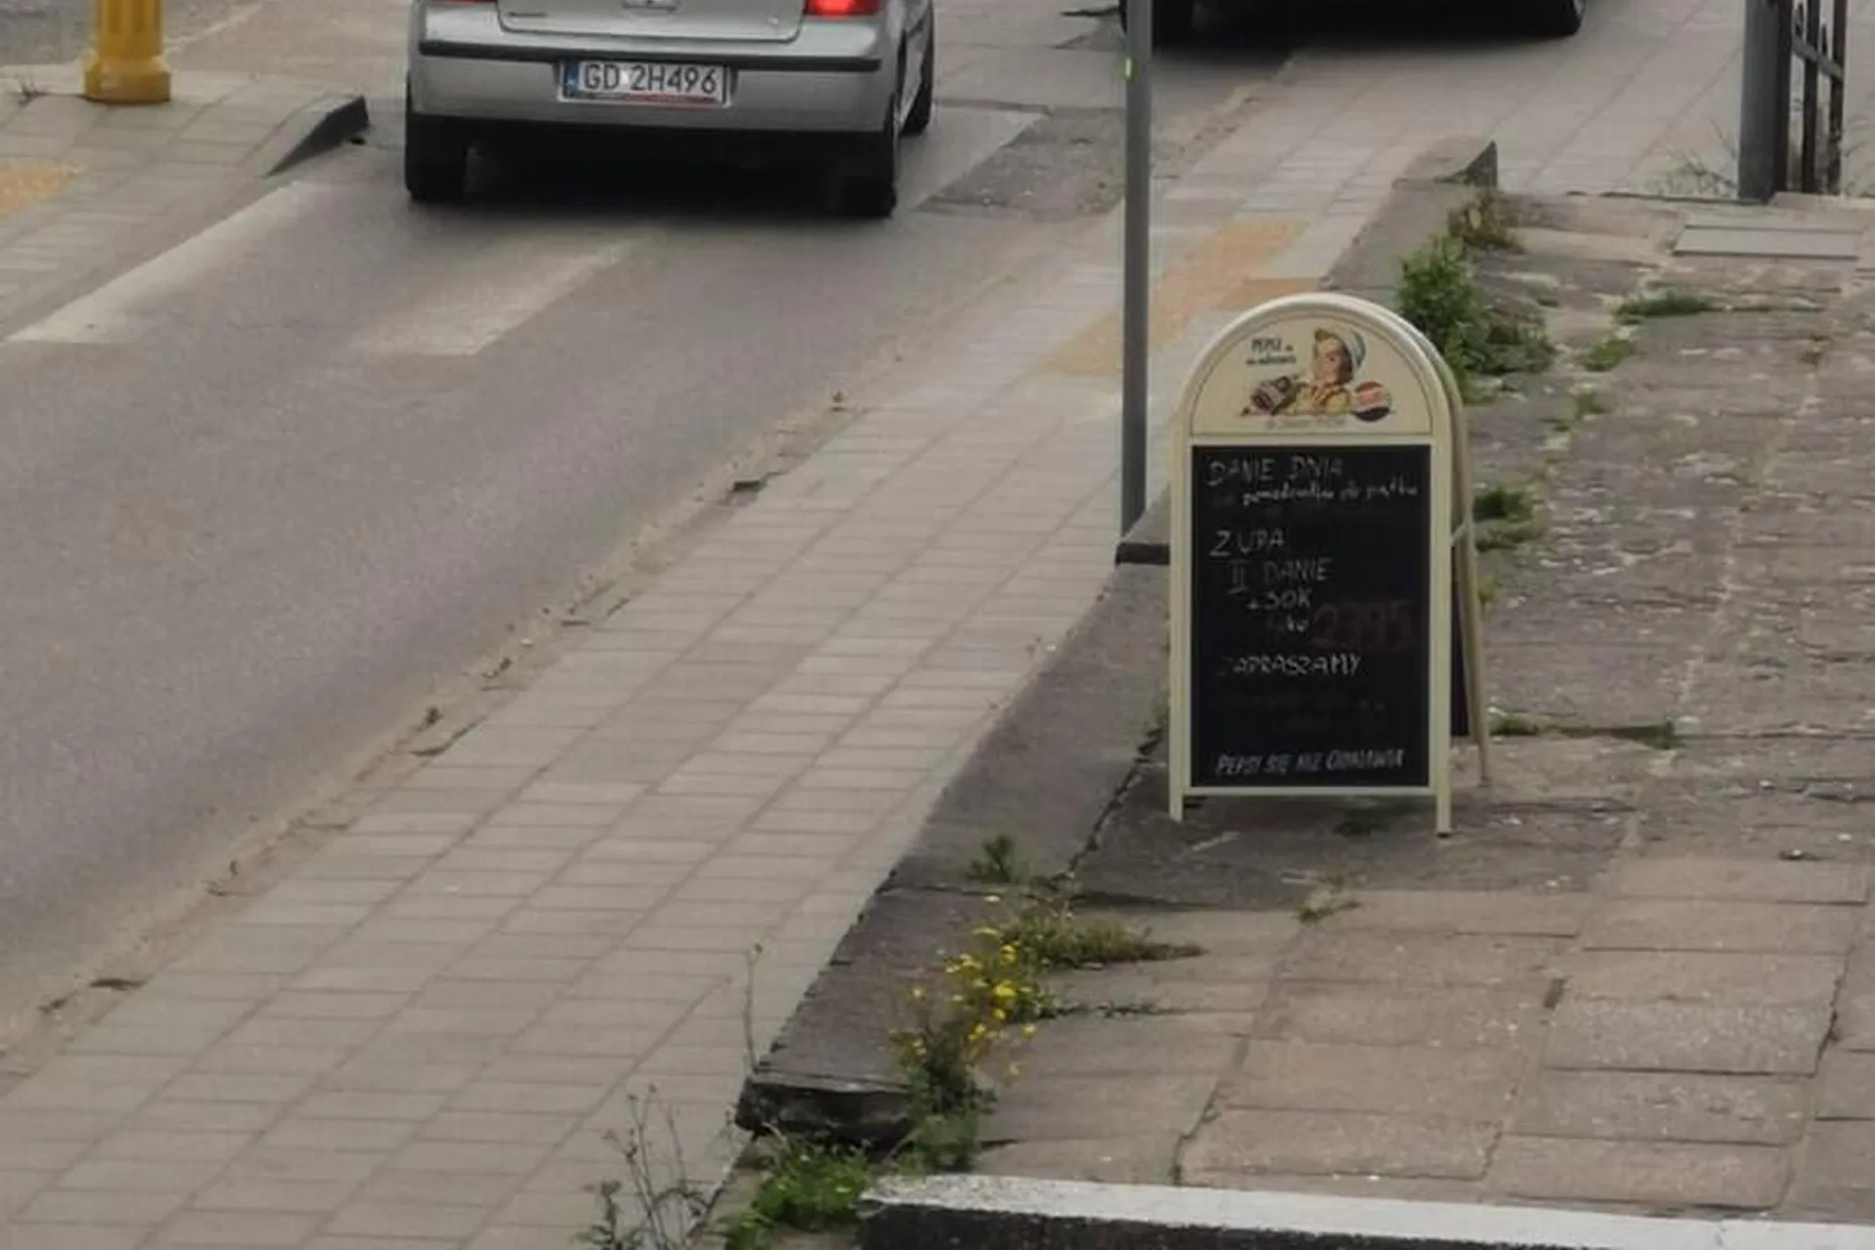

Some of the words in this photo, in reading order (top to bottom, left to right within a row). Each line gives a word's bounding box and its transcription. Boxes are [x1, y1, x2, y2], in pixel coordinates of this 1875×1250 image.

[584, 64, 620, 90] GD
[630, 65, 717, 95] 2H496
[1209, 528, 1286, 558] ZUPA
